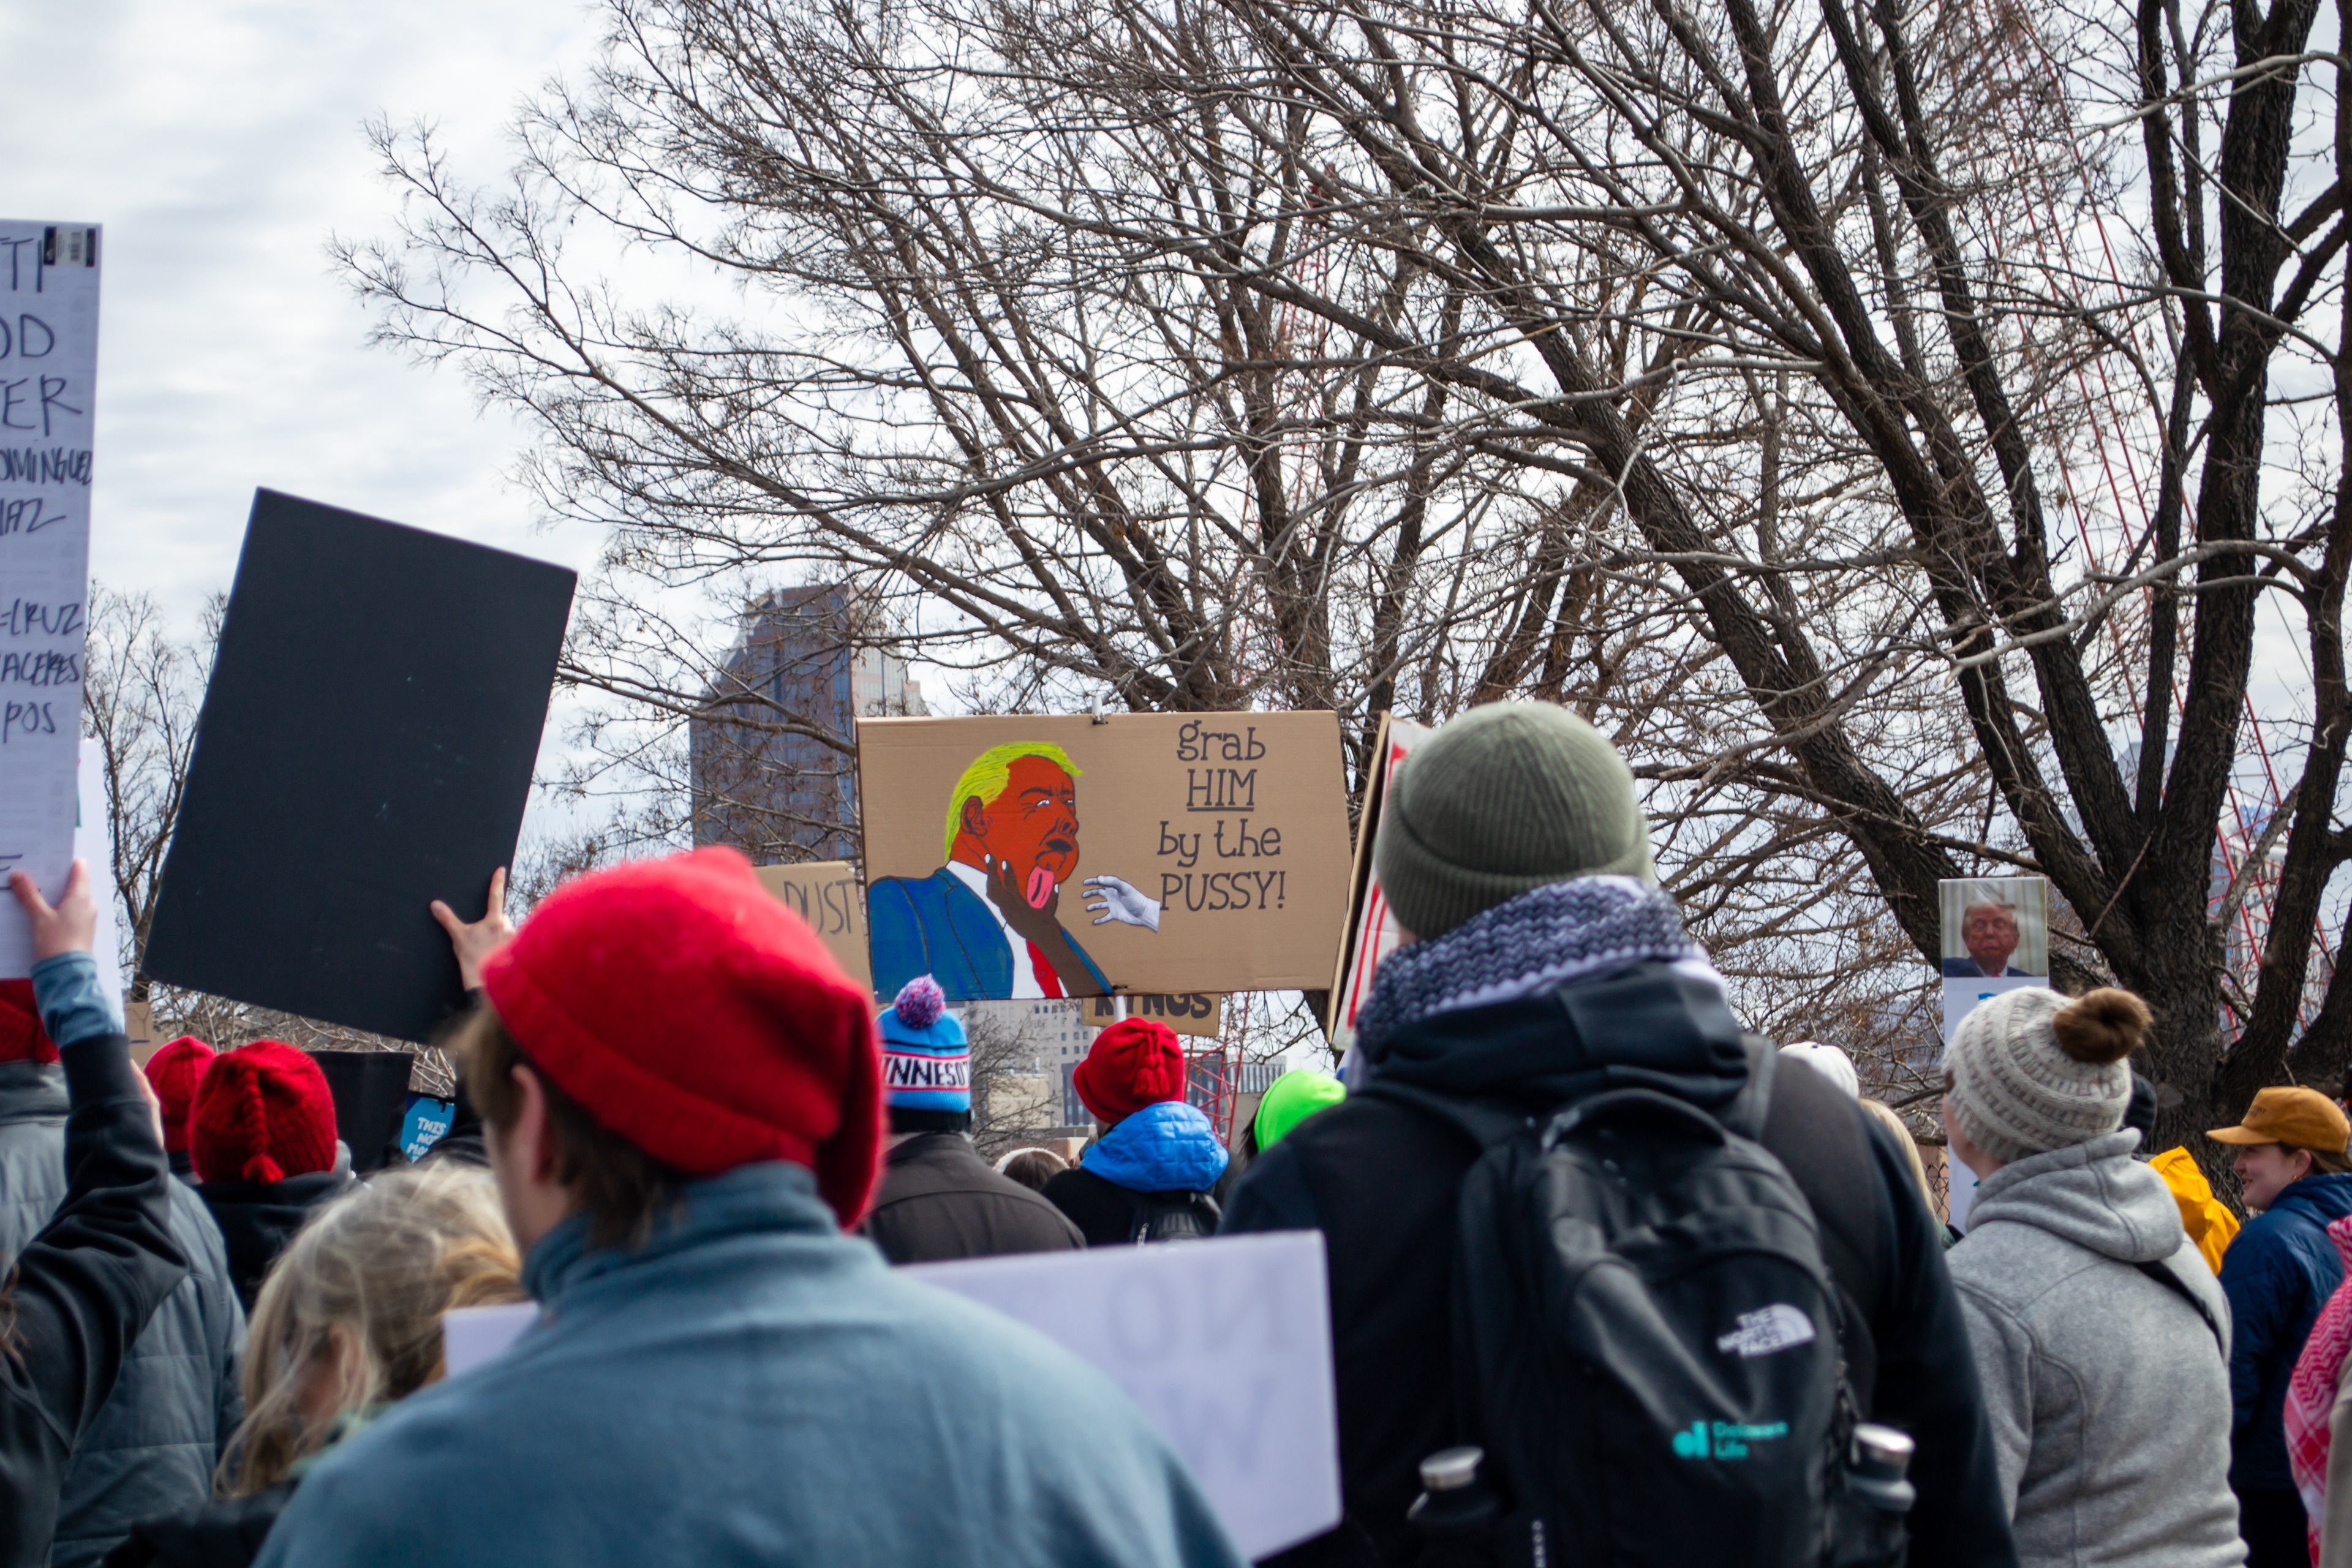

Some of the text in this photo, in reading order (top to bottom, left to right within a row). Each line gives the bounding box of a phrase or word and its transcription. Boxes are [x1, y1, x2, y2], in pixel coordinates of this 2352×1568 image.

[0, 374, 83, 437] ER
[1177, 719, 1266, 761] grab
[1186, 768, 1257, 807] HIM
[1157, 818, 1281, 867] by the
[1160, 870, 1286, 911] PUSSY!
[418, 1117, 447, 1136] THIS
